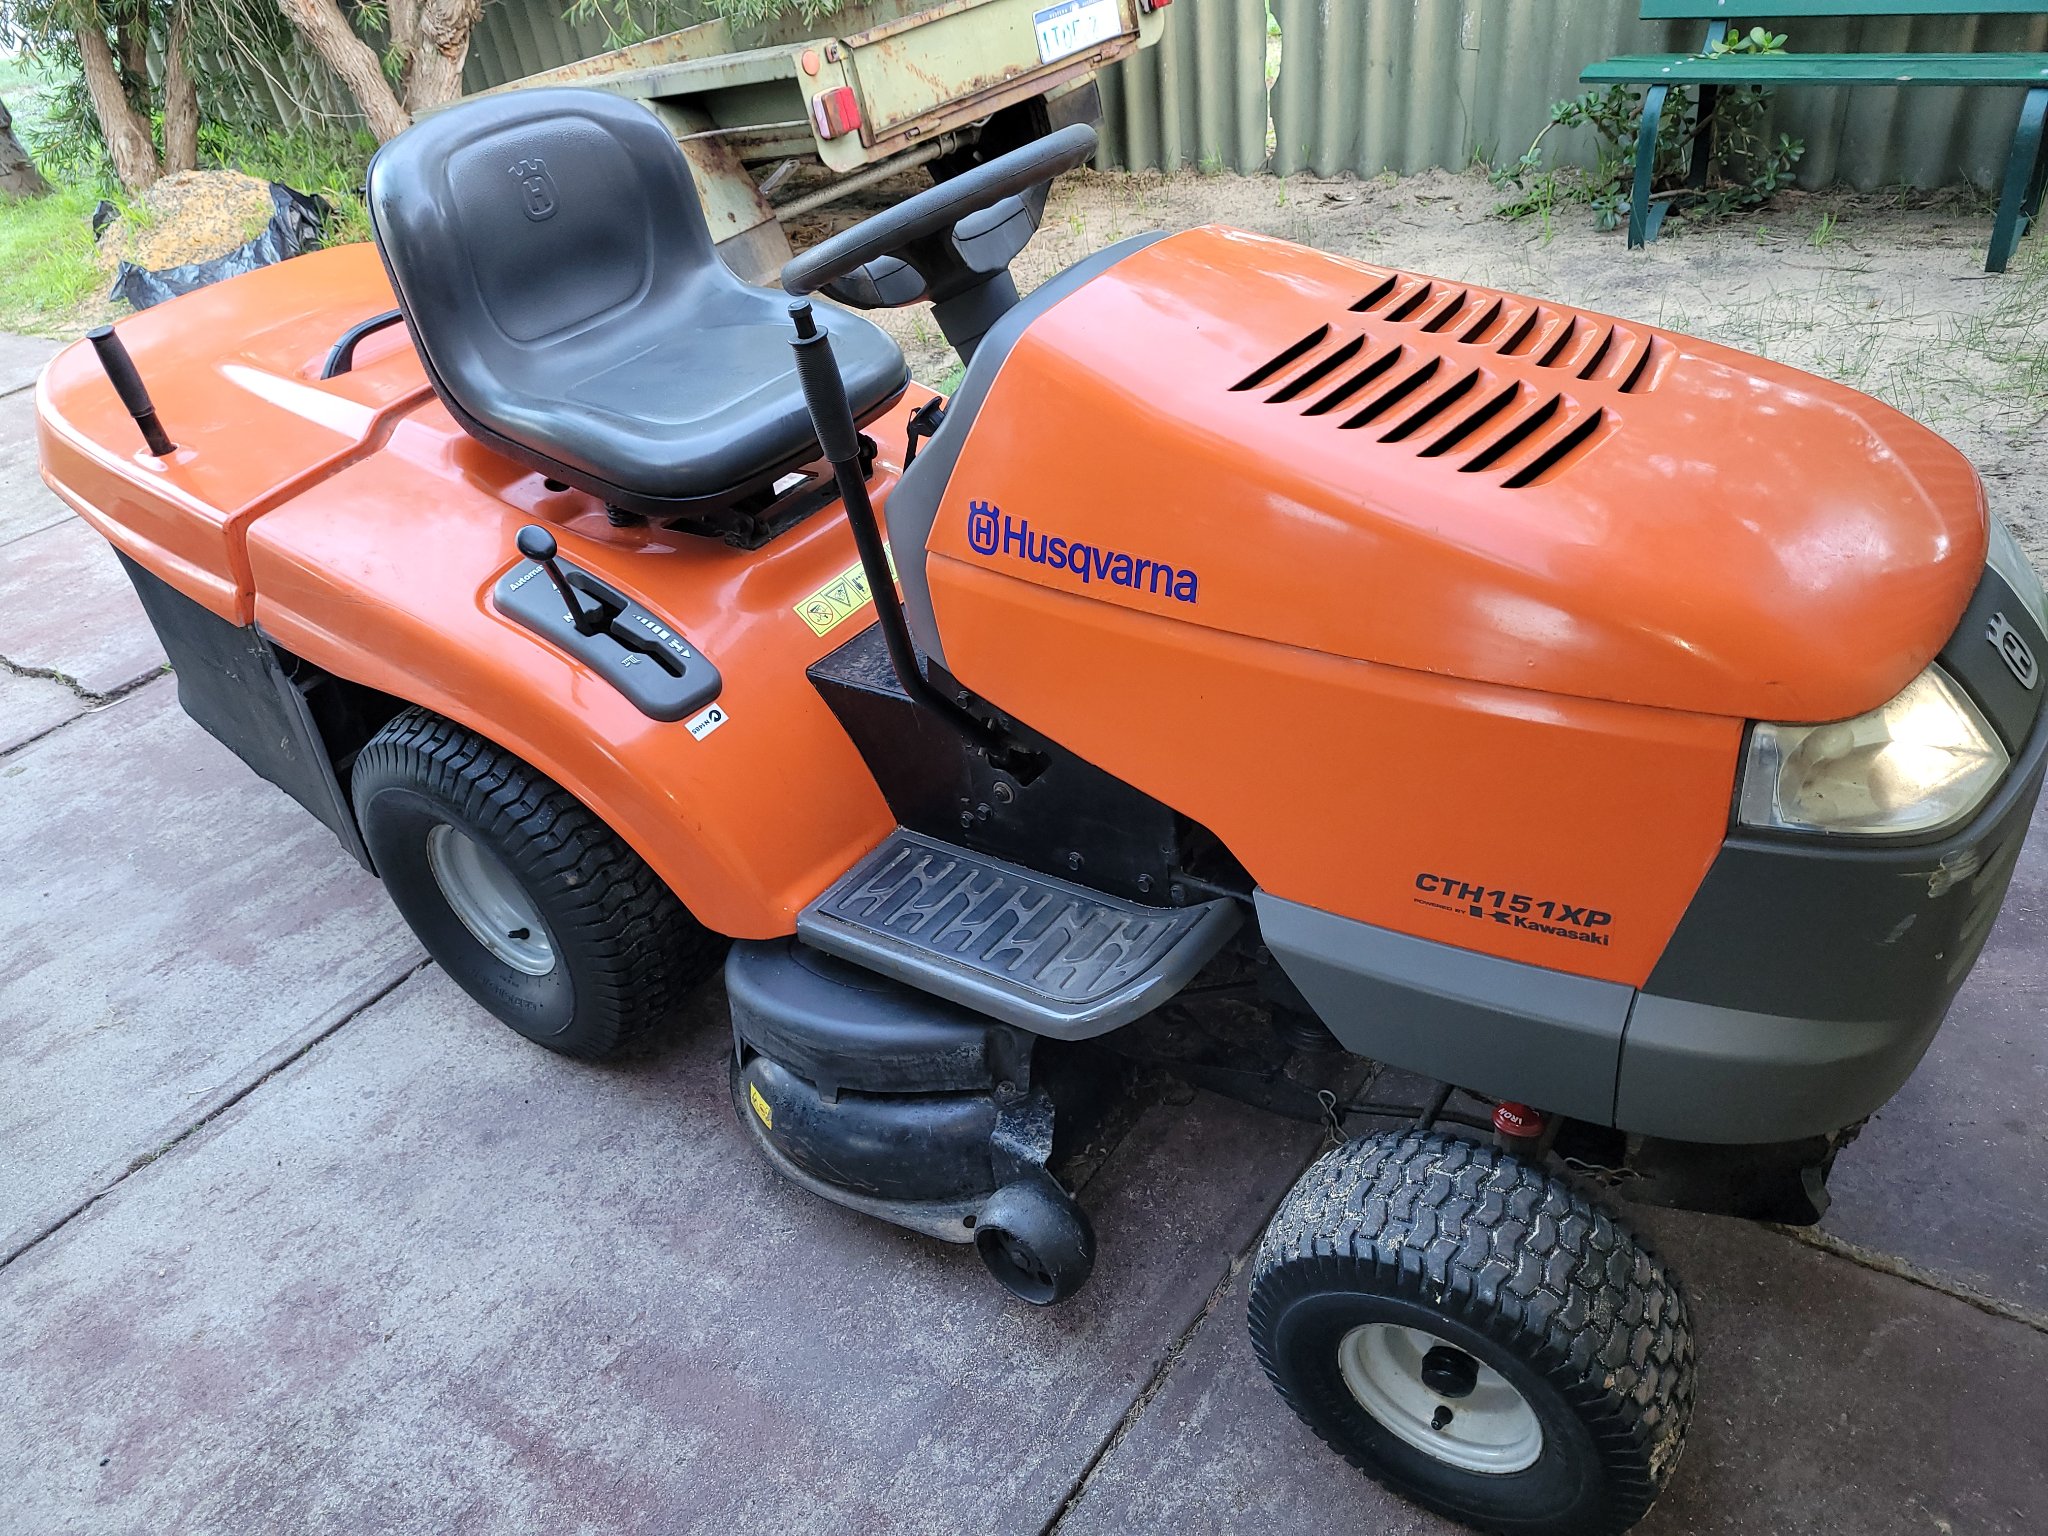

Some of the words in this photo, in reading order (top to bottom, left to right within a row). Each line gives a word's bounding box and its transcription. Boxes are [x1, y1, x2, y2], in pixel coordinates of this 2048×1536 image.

[509, 564, 545, 592] Automa
[1002, 515, 1199, 604] Husqvarna
[1413, 897, 1454, 912] POWERED
[1454, 907, 1467, 915] BY
[1513, 915, 1610, 946] Kawasaki
[1415, 872, 1612, 929] CTH151XP
